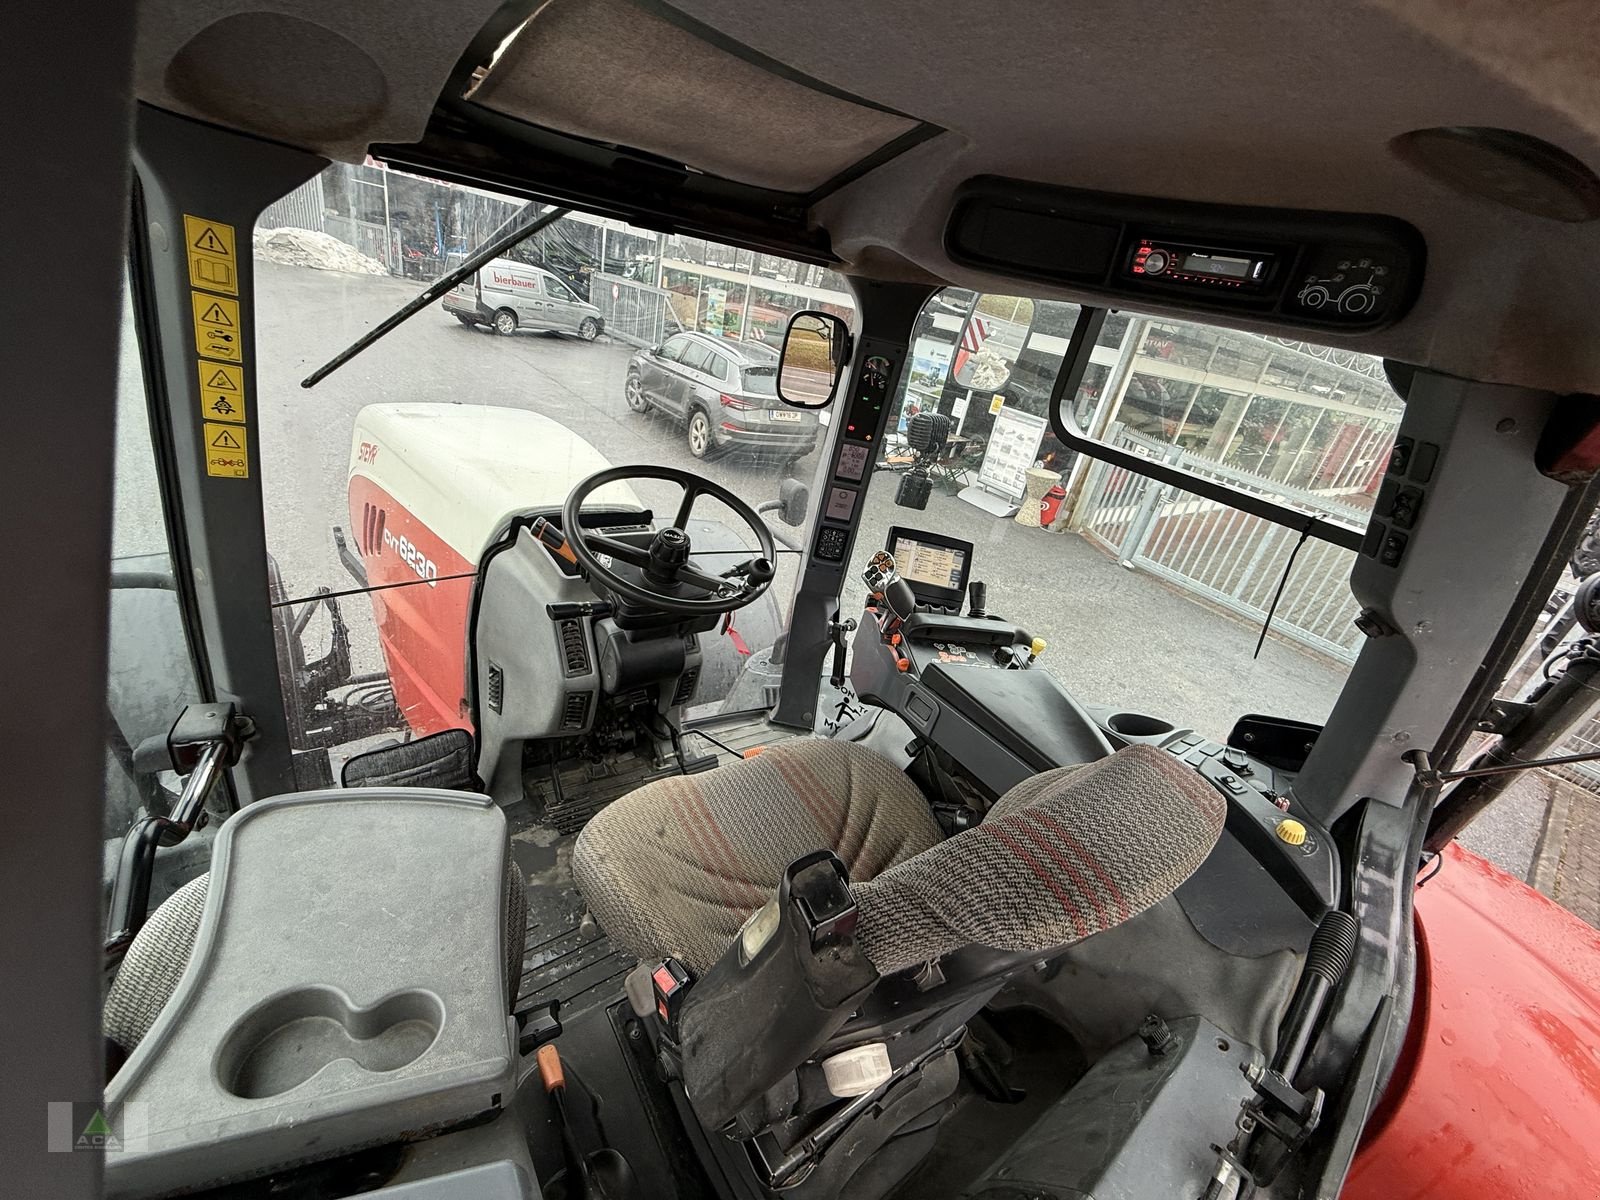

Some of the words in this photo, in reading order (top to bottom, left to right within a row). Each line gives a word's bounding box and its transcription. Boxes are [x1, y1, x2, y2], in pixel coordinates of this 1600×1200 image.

[493, 271, 537, 289] bierbauer
[358, 441, 379, 465] STEYR
[383, 527, 400, 555] CVT
[399, 534, 437, 588] 6230
